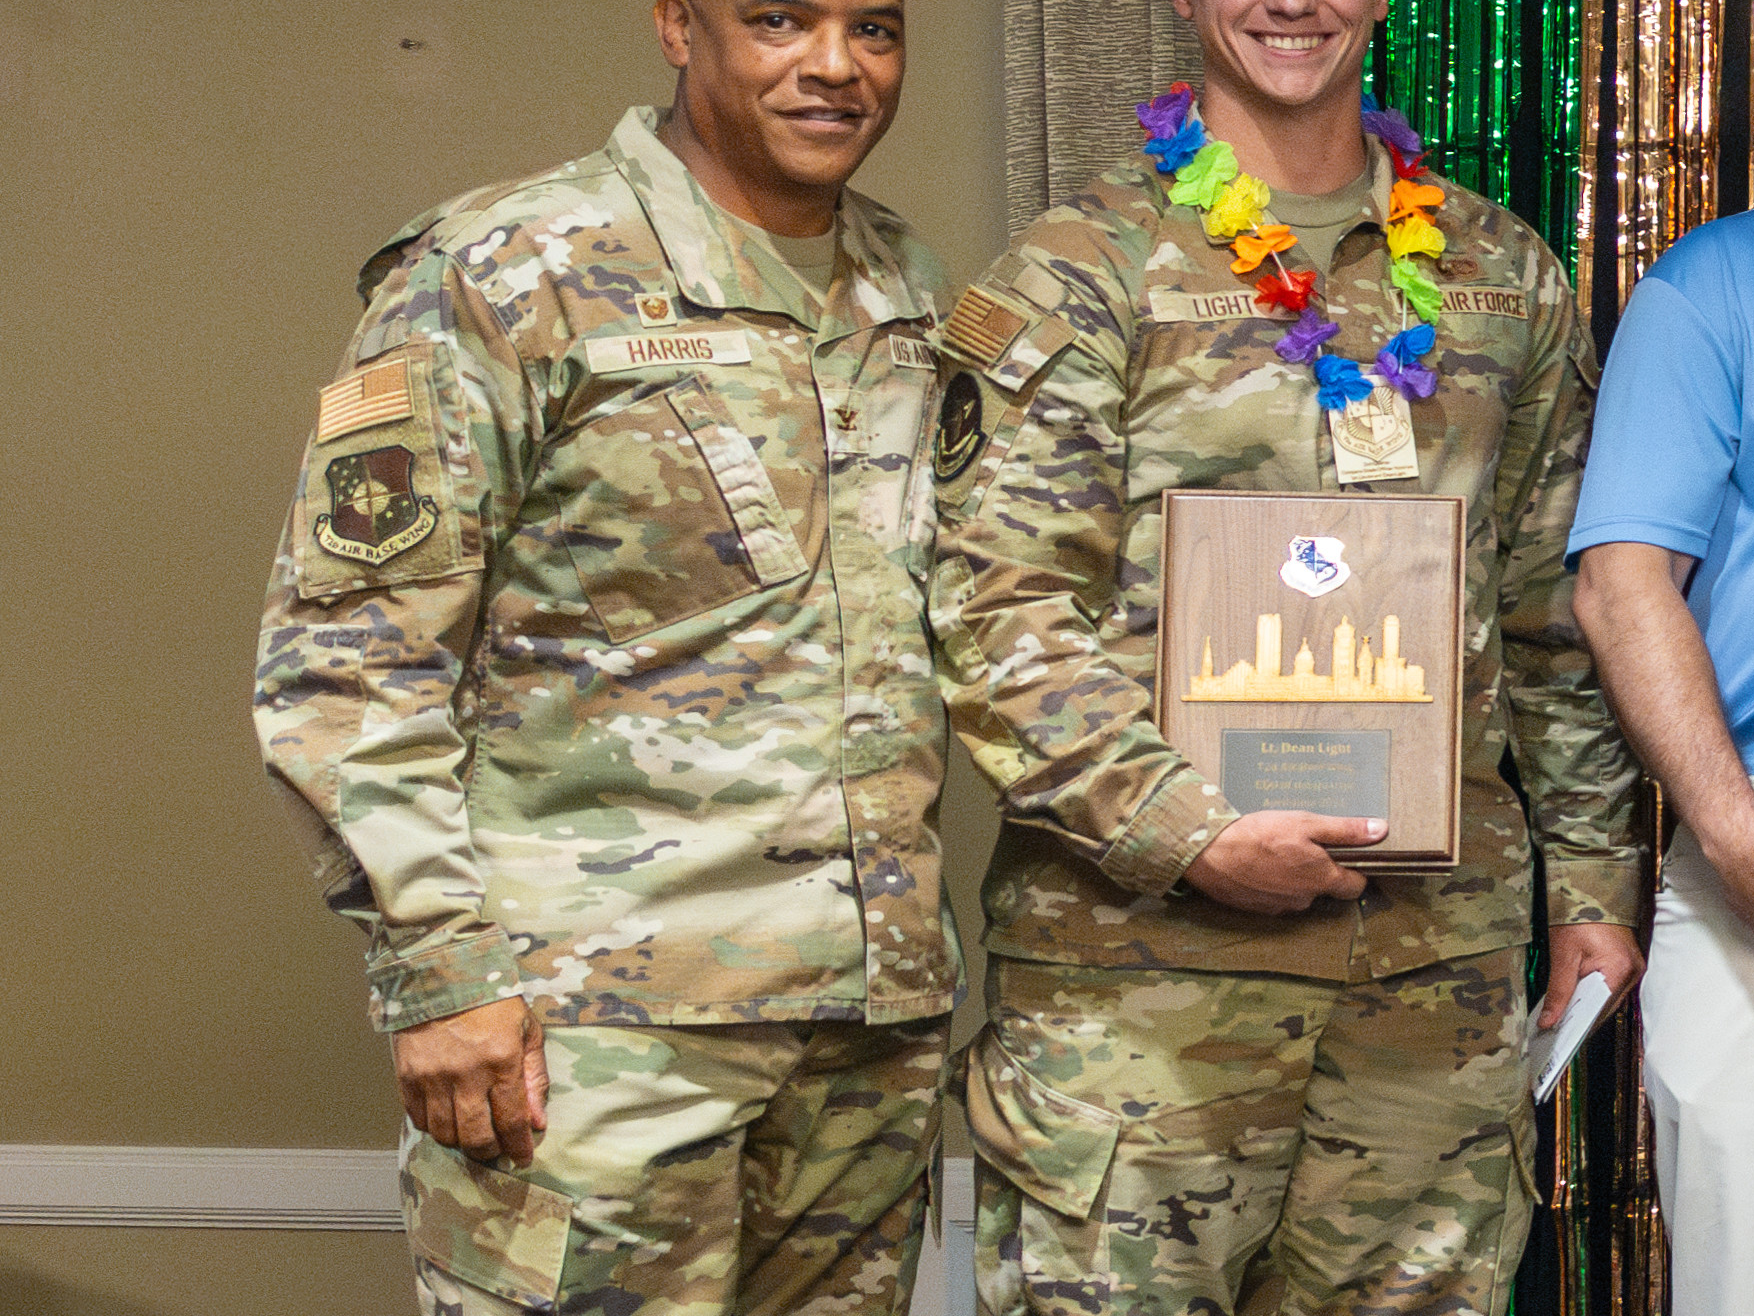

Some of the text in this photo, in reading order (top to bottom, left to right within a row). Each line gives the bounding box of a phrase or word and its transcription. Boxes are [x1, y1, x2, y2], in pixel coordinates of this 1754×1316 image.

[1193, 294, 1253, 318] LIGHT
[1472, 291, 1526, 317] FORCE
[626, 338, 713, 363] HARRIS
[339, 544, 361, 557] AIR
[365, 543, 398, 560] BASE
[399, 519, 430, 544] WING
